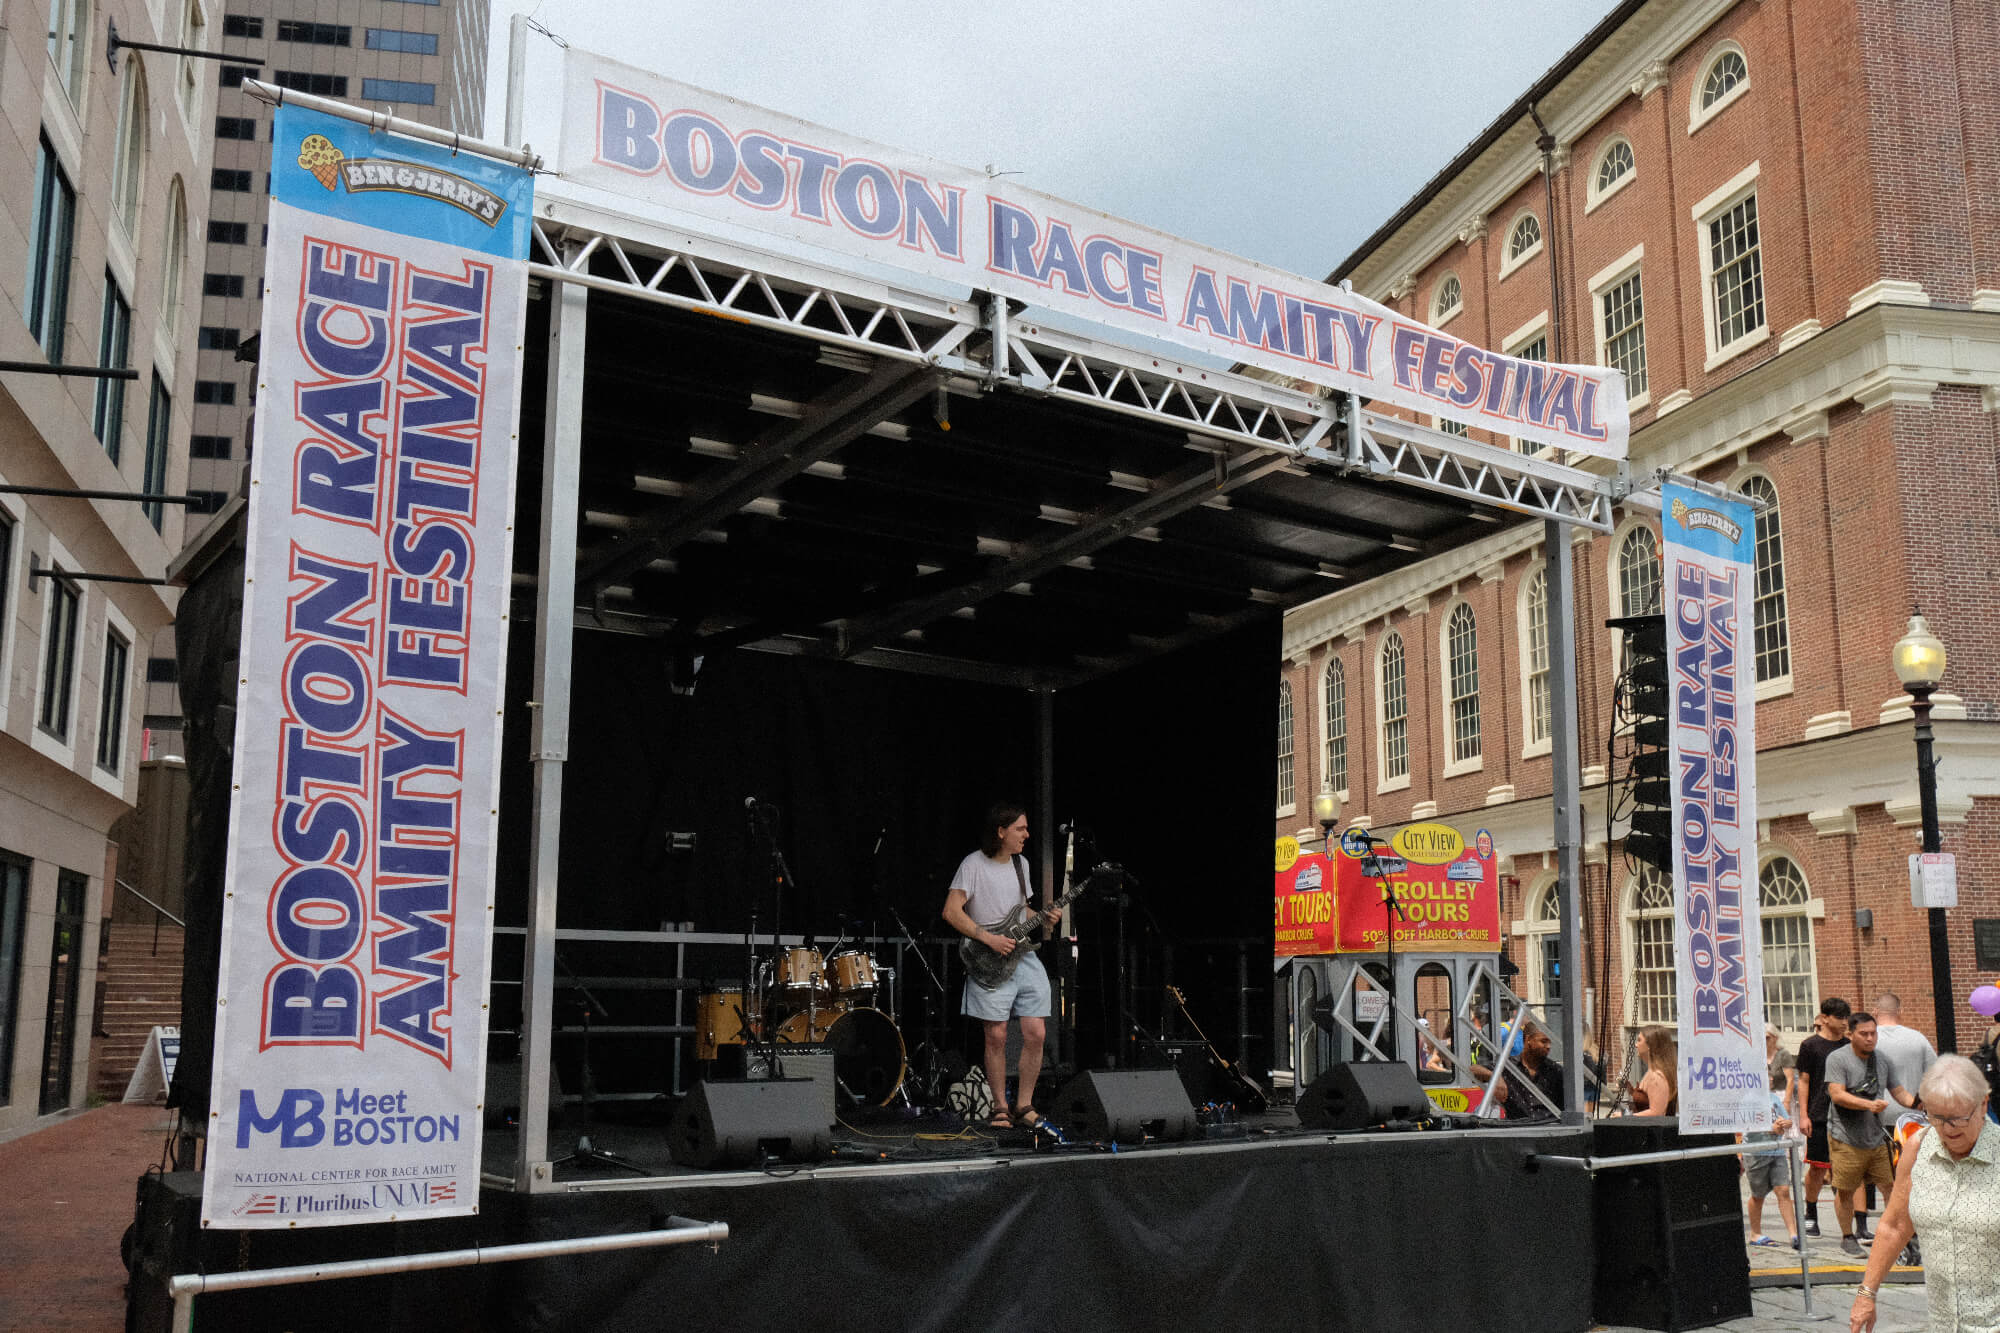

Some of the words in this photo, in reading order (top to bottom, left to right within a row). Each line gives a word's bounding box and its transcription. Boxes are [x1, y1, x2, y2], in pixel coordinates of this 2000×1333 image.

[593, 79, 966, 263] BOSTON
[986, 195, 1166, 322] RACE
[1180, 265, 1382, 380] AMITY
[1392, 320, 1609, 442] FESTIVAL
[295, 238, 397, 532] RACE
[380, 261, 492, 694] FESTIVAL
[1676, 560, 1707, 733] RACE
[1708, 567, 1739, 828] FESTIVAL
[261, 542, 376, 1050] BOSTON
[1403, 830, 1425, 850] CITY
[1429, 831, 1456, 850] VIEW
[373, 701, 464, 1068] AMITY
[1376, 882, 1477, 901] TROLLEY
[1679, 747, 1723, 1036] BOSTON
[1289, 891, 1332, 926] TOURS
[1392, 903, 1470, 922] TOURS
[1296, 928, 1314, 941] CRUISE
[1363, 930, 1389, 942] 50%
[1394, 929, 1416, 941] OFF
[1418, 929, 1464, 941] HARBOR
[1465, 929, 1489, 941] CRUISE
[1712, 833, 1751, 1046] AMITY
[1719, 1056, 1743, 1073] Meet
[1720, 1073, 1762, 1090] BOSTON
[335, 1087, 407, 1115] Meet
[334, 1115, 460, 1147] BOSTON
[235, 1172, 306, 1184] NATIONAL
[311, 1169, 361, 1181] CENTER
[365, 1167, 388, 1179] FOR
[392, 1165, 419, 1177] RACE
[422, 1163, 457, 1175] AMITY
[279, 1196, 291, 1214] E
[296, 1192, 371, 1213] Pluribus
